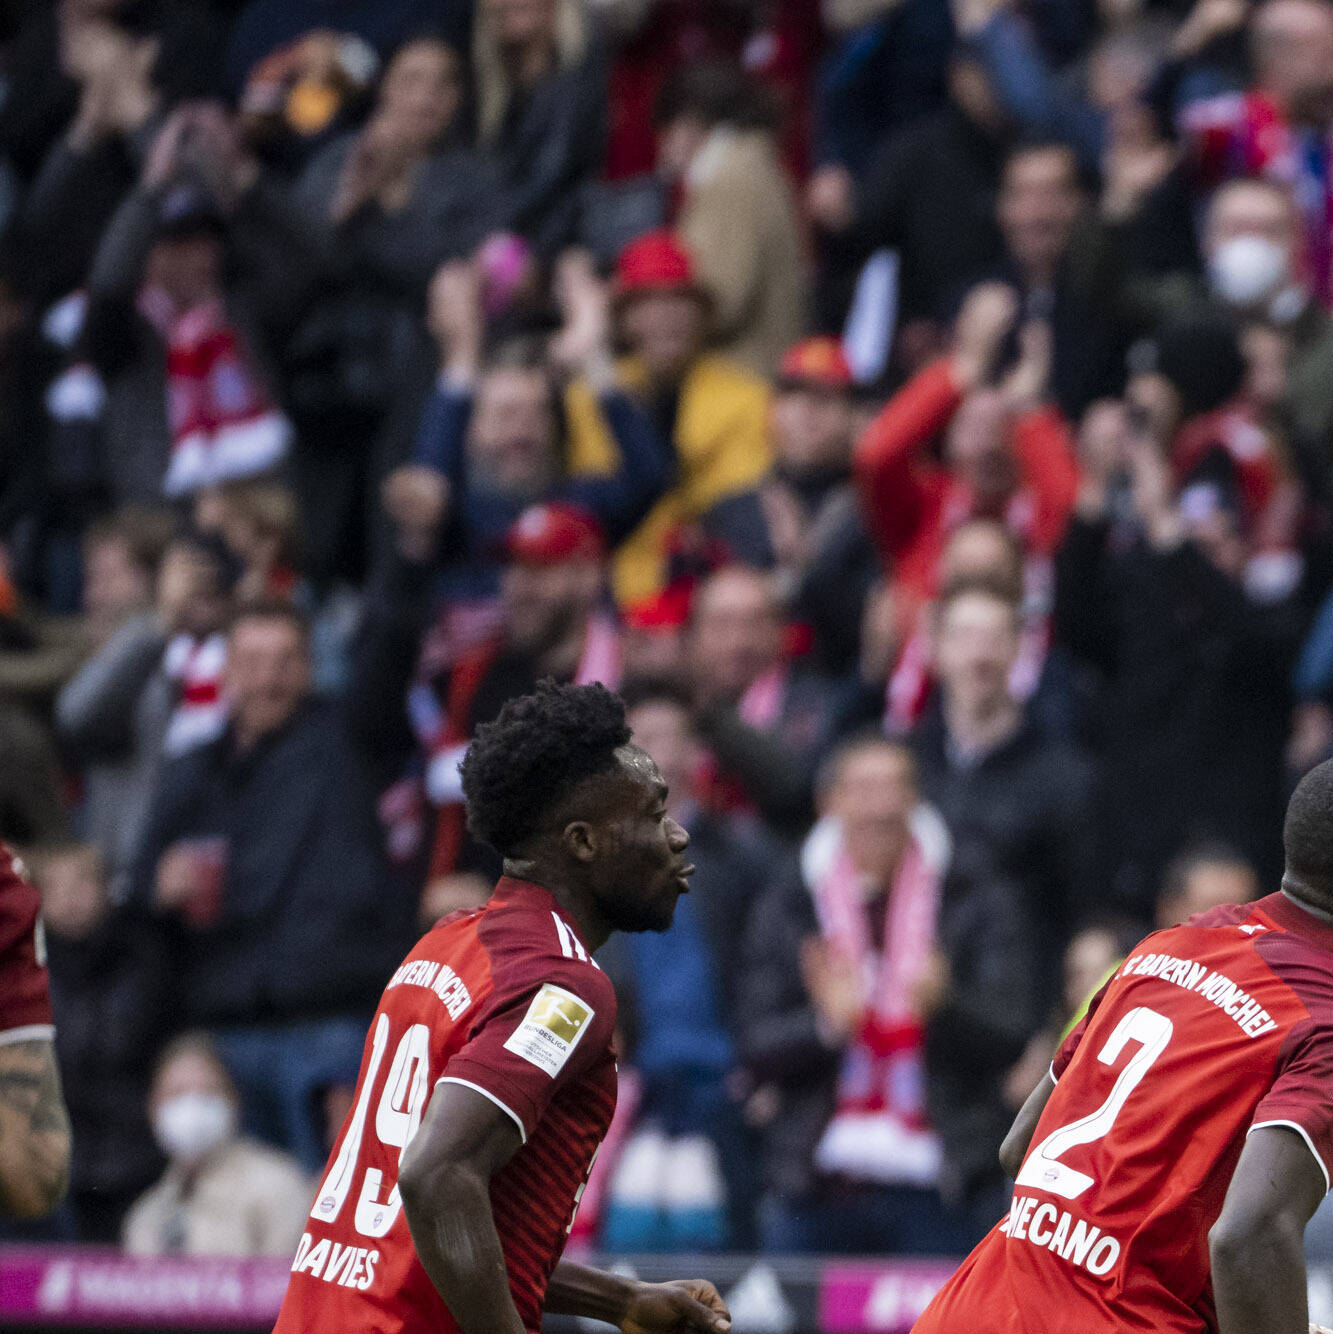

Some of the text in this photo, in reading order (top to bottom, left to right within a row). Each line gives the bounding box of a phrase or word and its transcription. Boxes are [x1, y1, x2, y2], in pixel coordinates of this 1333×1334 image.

[1133, 954, 1208, 991] BAYERN
[310, 1012, 430, 1238] 19
[1015, 1006, 1173, 1200] 2
[291, 1232, 380, 1291] DAVIES
[999, 1196, 1121, 1276] MECANO
